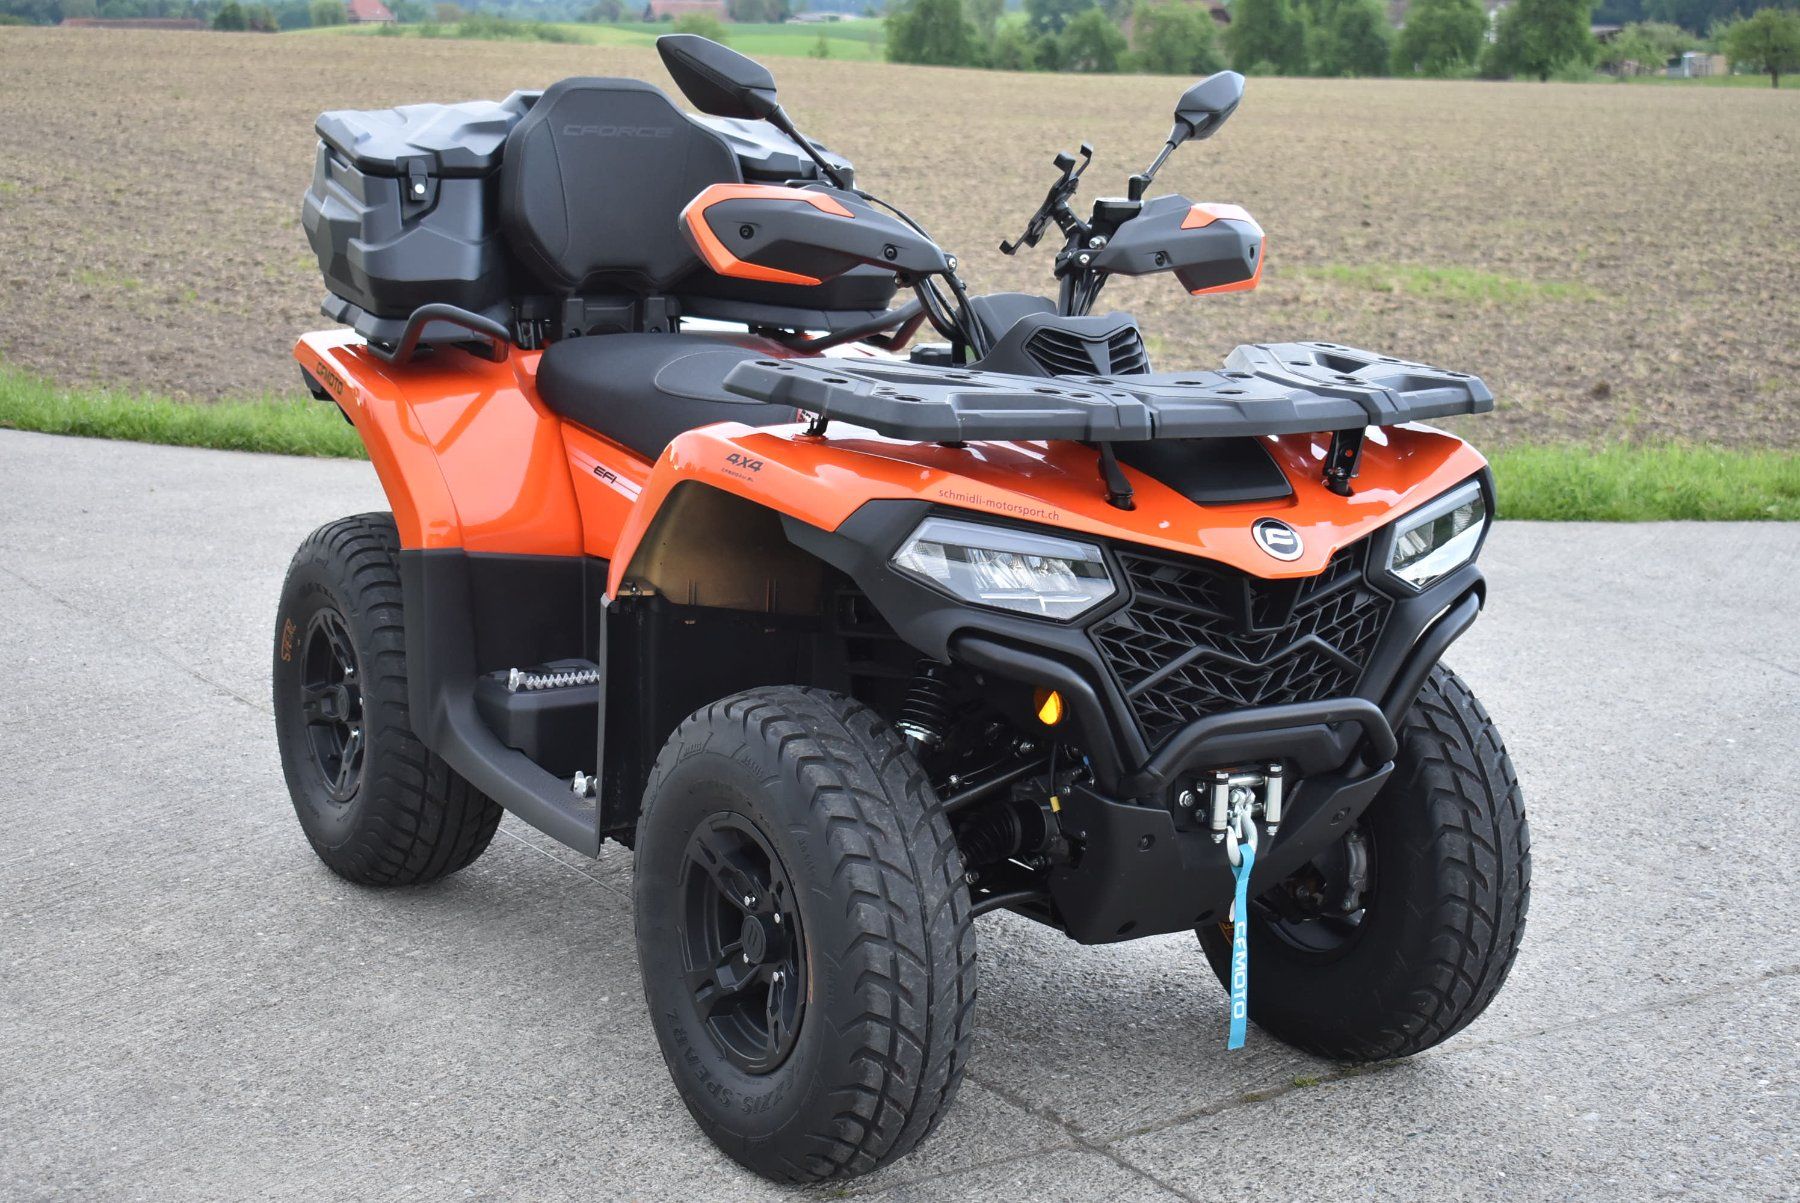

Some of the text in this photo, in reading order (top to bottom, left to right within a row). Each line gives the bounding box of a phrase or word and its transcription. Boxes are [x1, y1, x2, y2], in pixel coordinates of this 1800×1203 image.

[562, 124, 675, 138] CFORCE
[315, 361, 344, 395] CFMOTO
[593, 465, 618, 484] EFI
[939, 489, 1059, 520] schmidli-motorsport.ch
[1233, 921, 1247, 1019] CFMOTO
